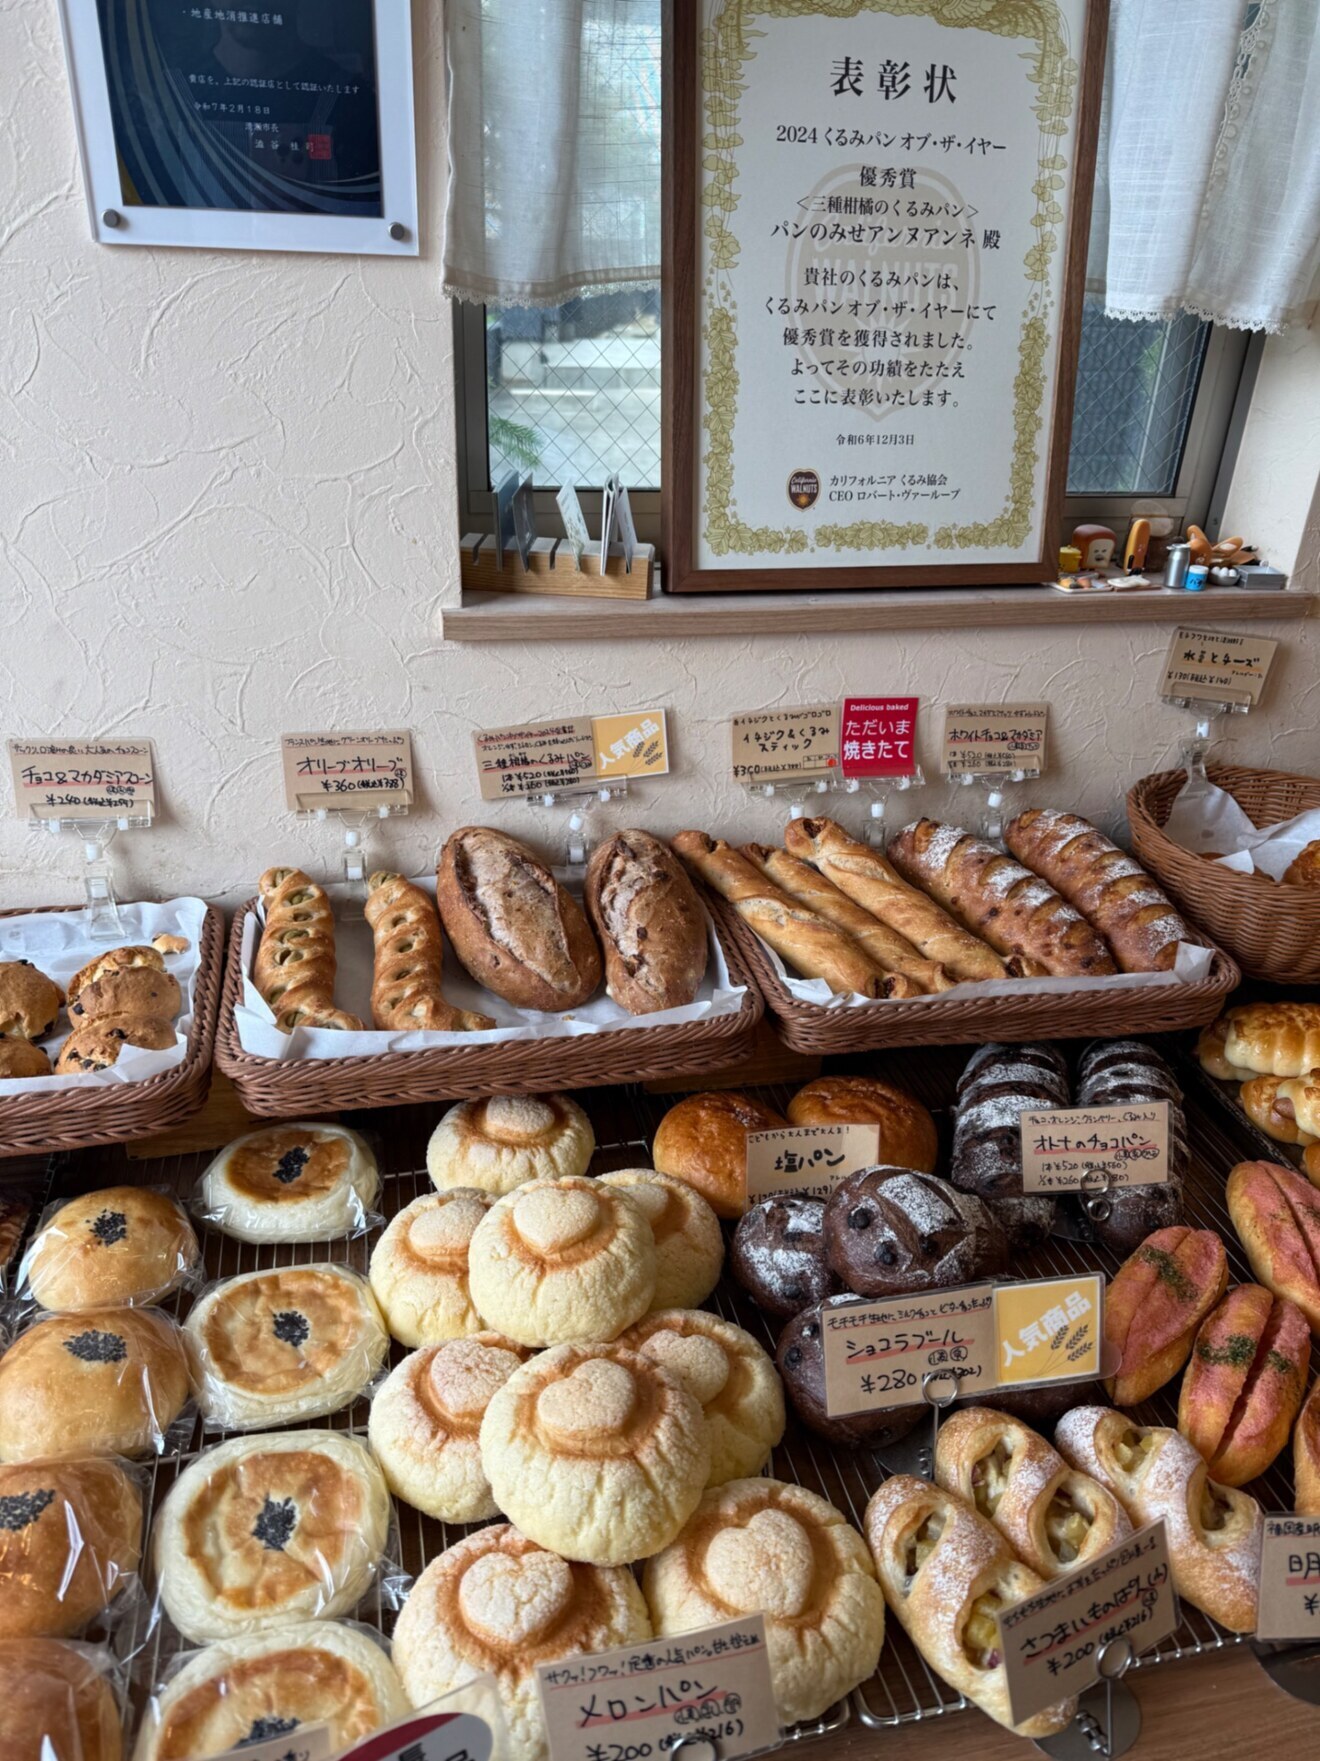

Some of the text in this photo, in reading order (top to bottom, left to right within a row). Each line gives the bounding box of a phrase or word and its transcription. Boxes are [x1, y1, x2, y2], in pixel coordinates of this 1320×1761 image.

[829, 56, 957, 104] 表彰状
[776, 125, 817, 145] 2024
[860, 166, 916, 189] 優秀賞
[771, 223, 1001, 251] パンのみせアンヌアンネ 殿
[804, 268, 960, 292] 貴社のくるみパンは、
[783, 328, 973, 351] 優秀賞を獲得されました。
[791, 358, 966, 379] よってその功績をたたえ
[794, 388, 959, 408] ここに表彰いたします。
[836, 434, 915, 446] 令和6年12月3日
[791, 485, 817, 494] WALNUTS
[830, 474, 948, 487] カリフォルニア くるみ協会
[829, 490, 853, 501] CEO
[886, 703, 909, 711] baked
[845, 719, 911, 736] ただいま
[598, 718, 661, 770] 人気商品
[758, 738, 813, 753] スティック
[843, 741, 910, 760] 焼きたて
[296, 756, 403, 775] オリーブオリーブ
[1033, 1133, 1152, 1152] オトナのチョコパン
[774, 1148, 846, 1173] 塩パン
[1002, 1291, 1092, 1367] 人気商品
[846, 1329, 964, 1359] ショコラブール
[861, 1369, 917, 1394] ¥280
[1046, 1642, 1095, 1676] ¥200
[580, 1680, 718, 1727] メロンパン
